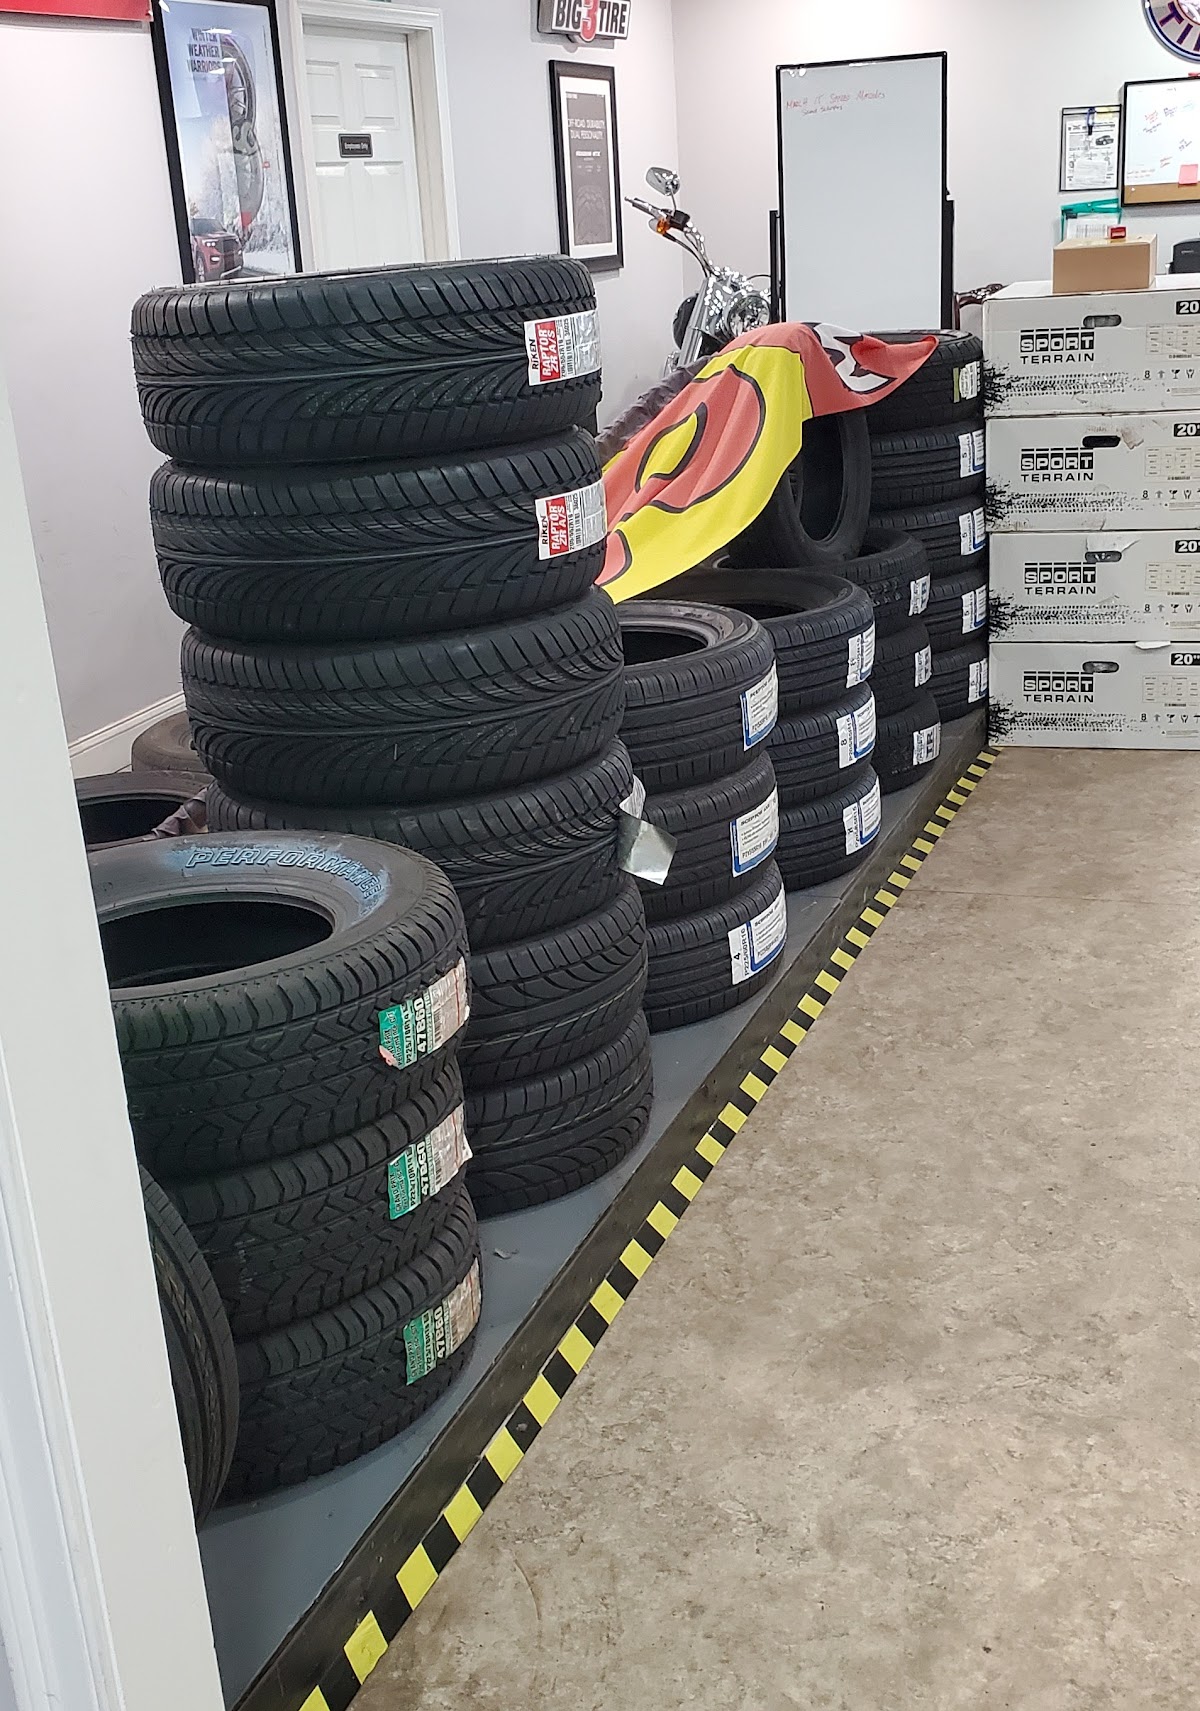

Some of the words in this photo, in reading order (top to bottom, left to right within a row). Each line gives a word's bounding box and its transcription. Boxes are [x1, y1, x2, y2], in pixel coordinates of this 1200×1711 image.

[556, 0, 582, 29] BIG
[581, 0, 597, 39] 3
[599, 1, 627, 34] TIRE
[187, 44, 220, 57] WEATHER
[187, 60, 221, 72] WARRIORS
[548, 329, 557, 353] A/S
[1021, 332, 1094, 352] SPORT
[529, 338, 539, 370] RIKEN
[538, 329, 552, 377] RAPTOR
[1020, 353, 1094, 365] TERRAIN
[550, 354, 559, 373] ZR
[1021, 452, 1093, 471] SPORT
[1021, 472, 1093, 483] TERRAIN
[557, 505, 566, 527] A/S
[540, 515, 549, 545] RIKEN
[549, 505, 561, 550] RAPTOR
[559, 529, 567, 546] ZR
[1024, 567, 1096, 584] SPORT
[1024, 586, 1096, 595] TERRAIN
[1023, 676, 1094, 692] SPORT
[1023, 694, 1094, 703] TERRAIN
[185, 848, 384, 901] PERFORMANCE
